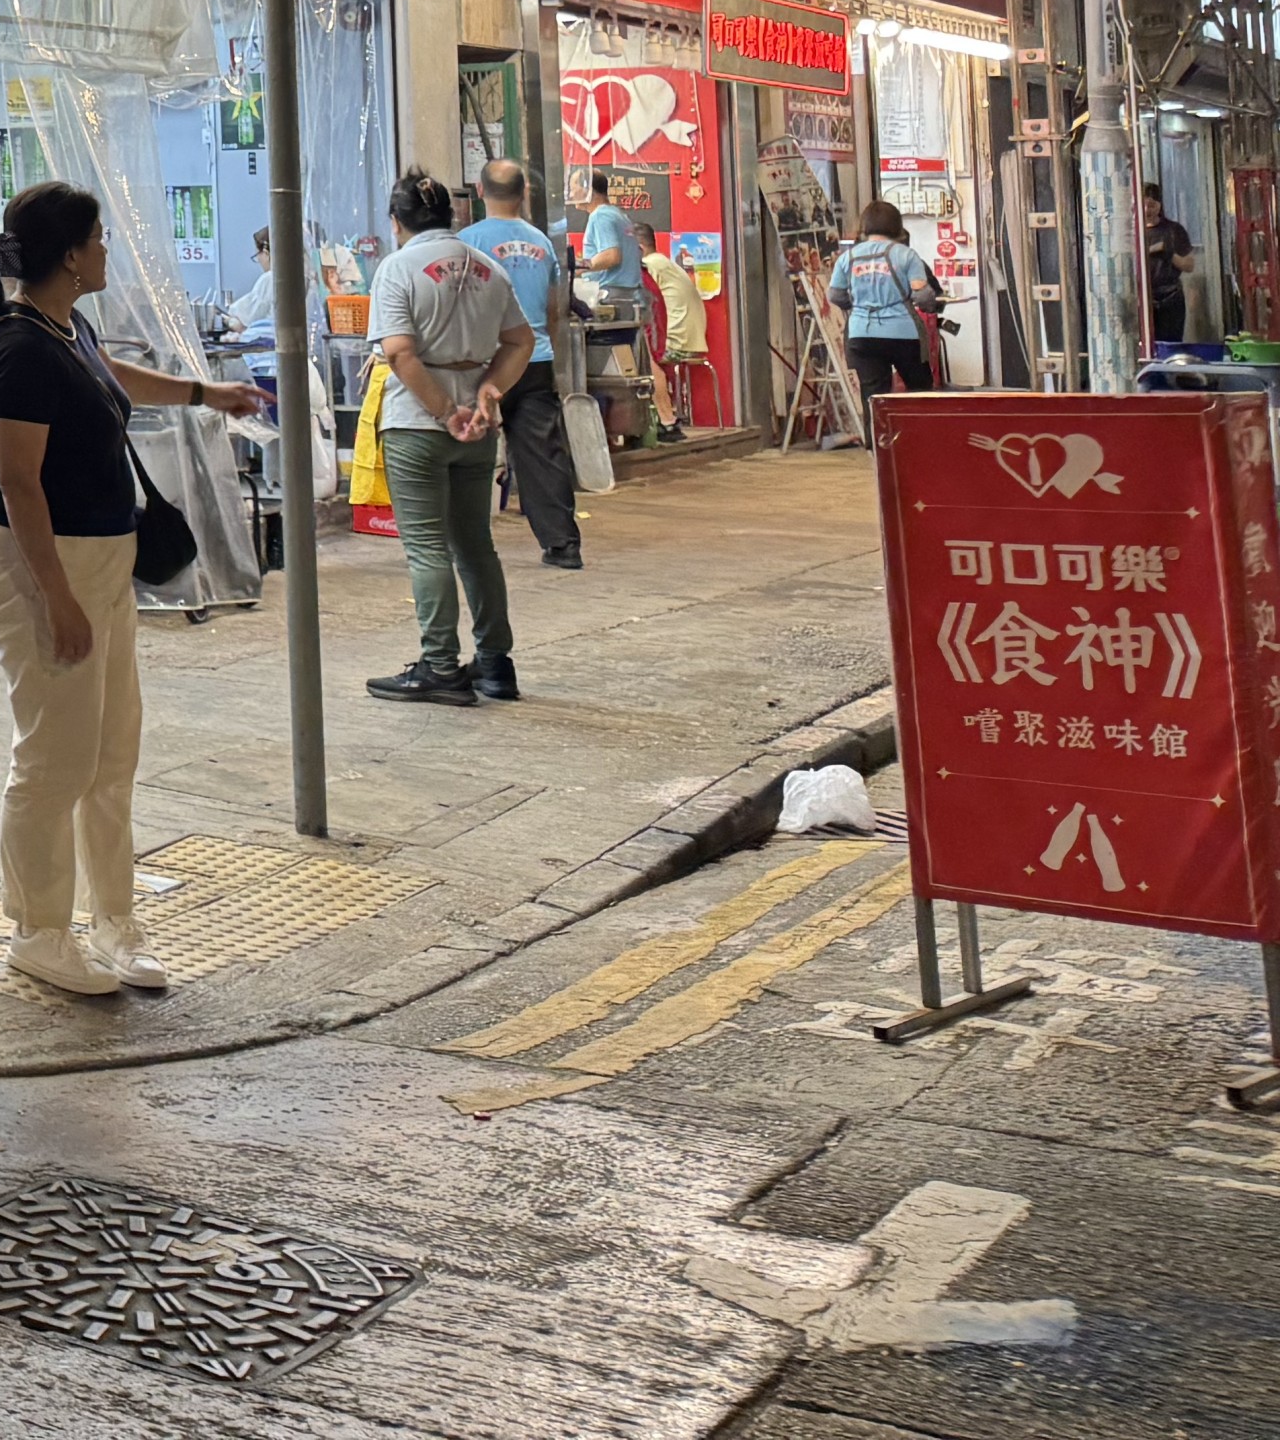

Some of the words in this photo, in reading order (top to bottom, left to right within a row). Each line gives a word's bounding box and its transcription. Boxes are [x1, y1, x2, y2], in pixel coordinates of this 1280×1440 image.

[183, 248, 203, 260] 35
[945, 539, 1167, 593] 可口可樂
[937, 600, 1202, 699] 《食神》
[963, 707, 1188, 758] 嚐聚滋味館
